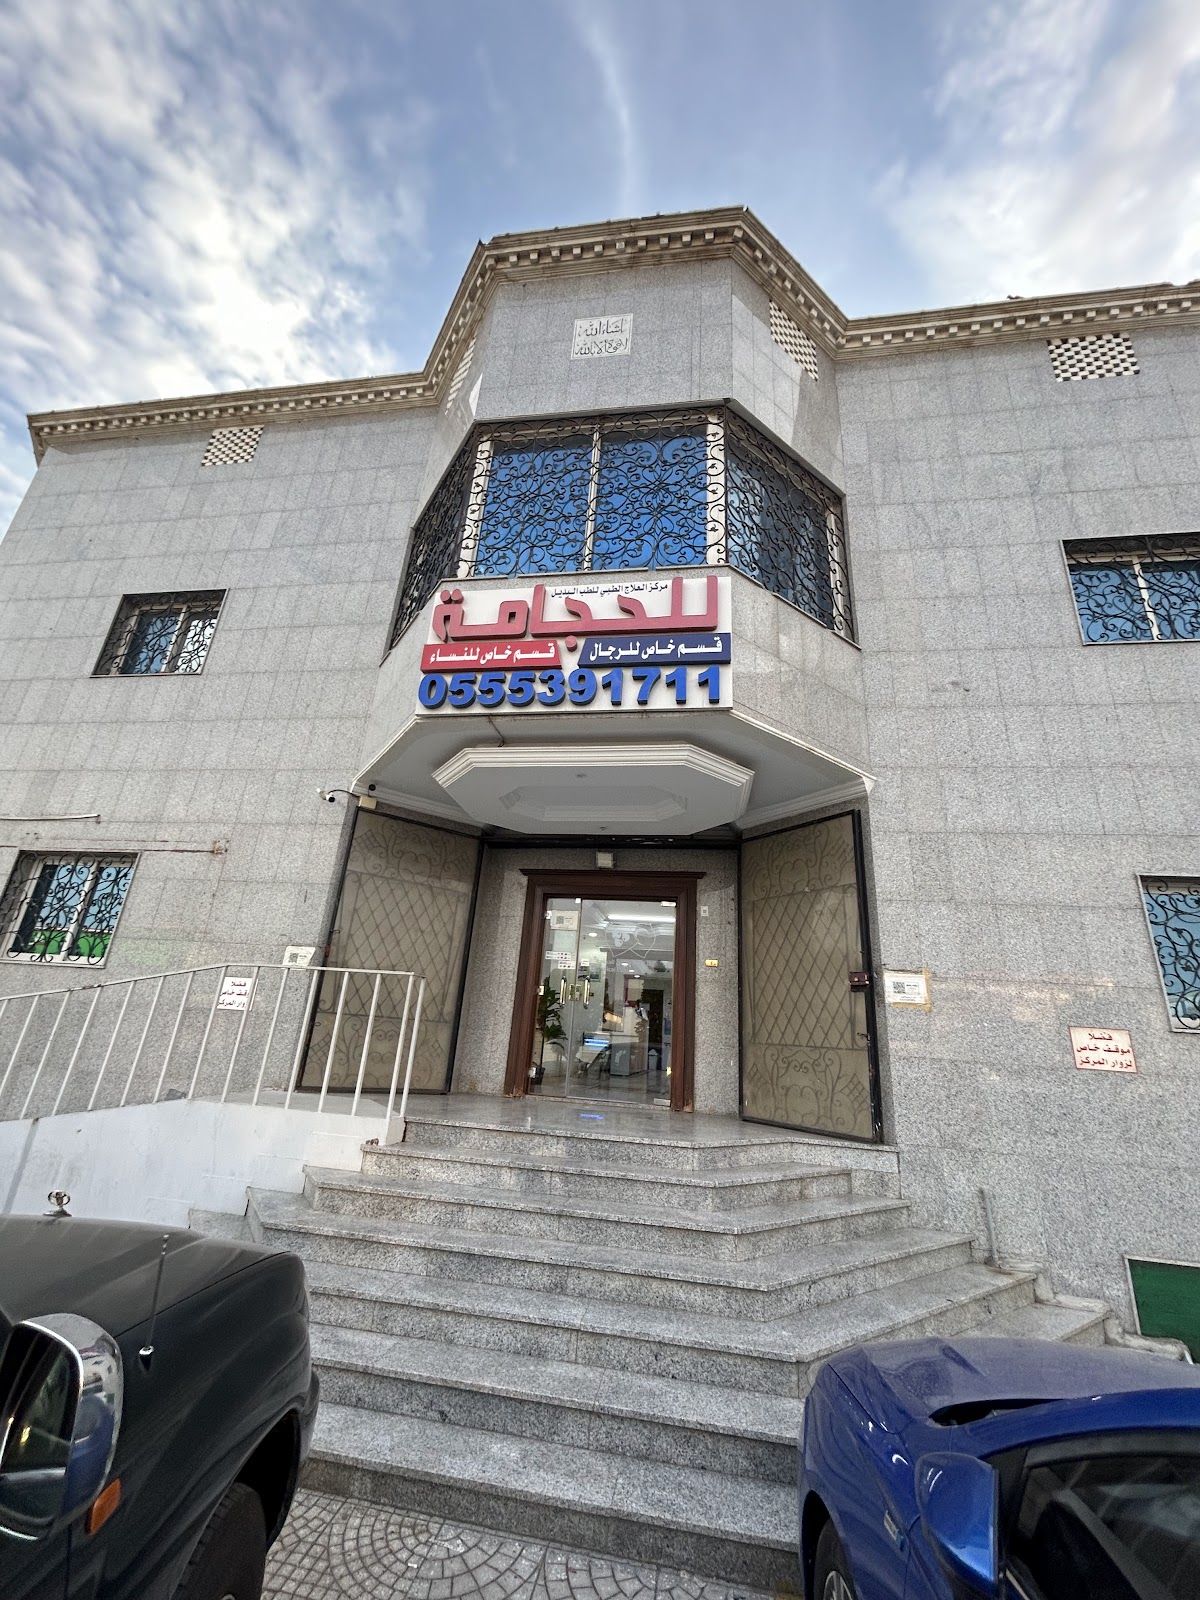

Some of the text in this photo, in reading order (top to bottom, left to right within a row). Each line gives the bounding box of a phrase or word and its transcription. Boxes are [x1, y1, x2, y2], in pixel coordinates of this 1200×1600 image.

[578, 321, 602, 337] الله
[551, 582, 668, 598] مركز العلاج الطبي للطب البديل
[432, 575, 718, 652] للحجامة
[429, 643, 555, 664] قسم خاص للنساء
[589, 636, 723, 661] قسم خاص للرجال
[418, 665, 720, 709] 0555391711
[1087, 1032, 1113, 1041] فضلا
[1076, 1043, 1131, 1056] موقف خاص
[1079, 1056, 1132, 1069] لزوار المركز
